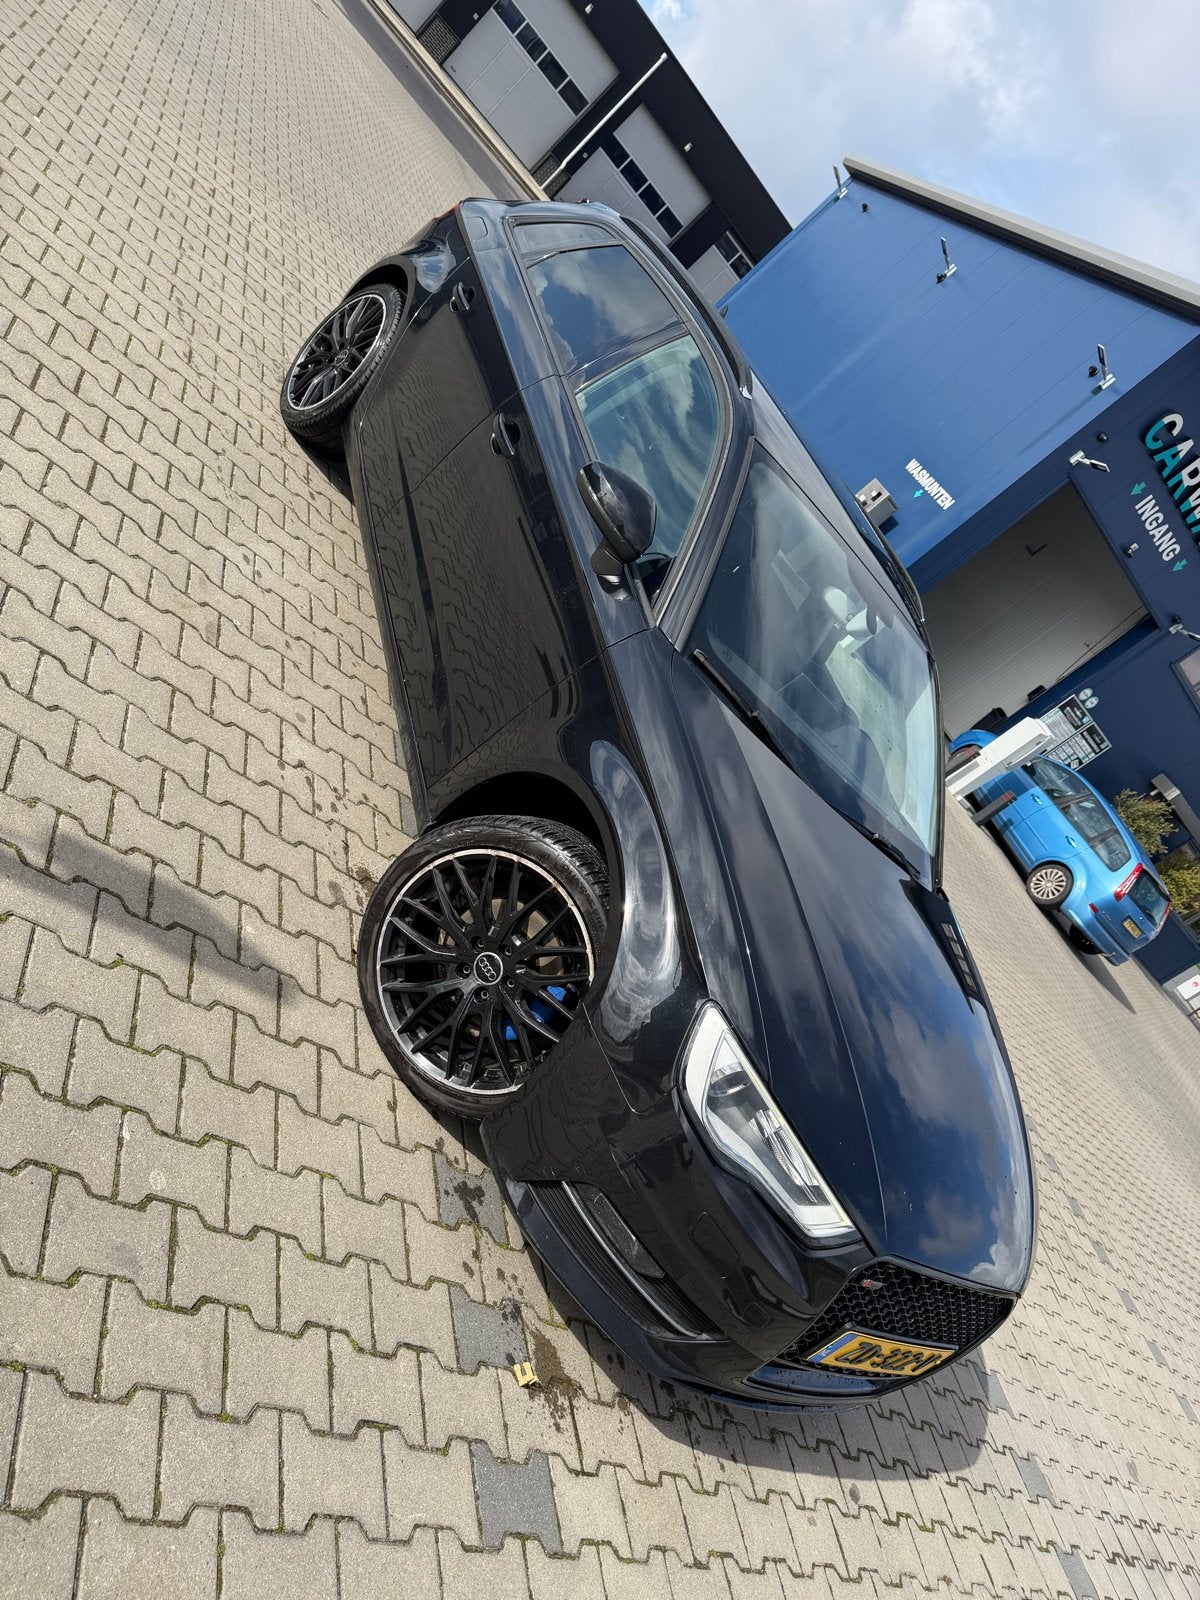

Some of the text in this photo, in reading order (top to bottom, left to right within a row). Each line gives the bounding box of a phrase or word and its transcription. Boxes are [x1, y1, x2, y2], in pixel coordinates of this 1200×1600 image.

[905, 458, 956, 511] WASMUNTEN
[1145, 413, 1200, 534] CARW
[1134, 493, 1181, 562] INGANG
